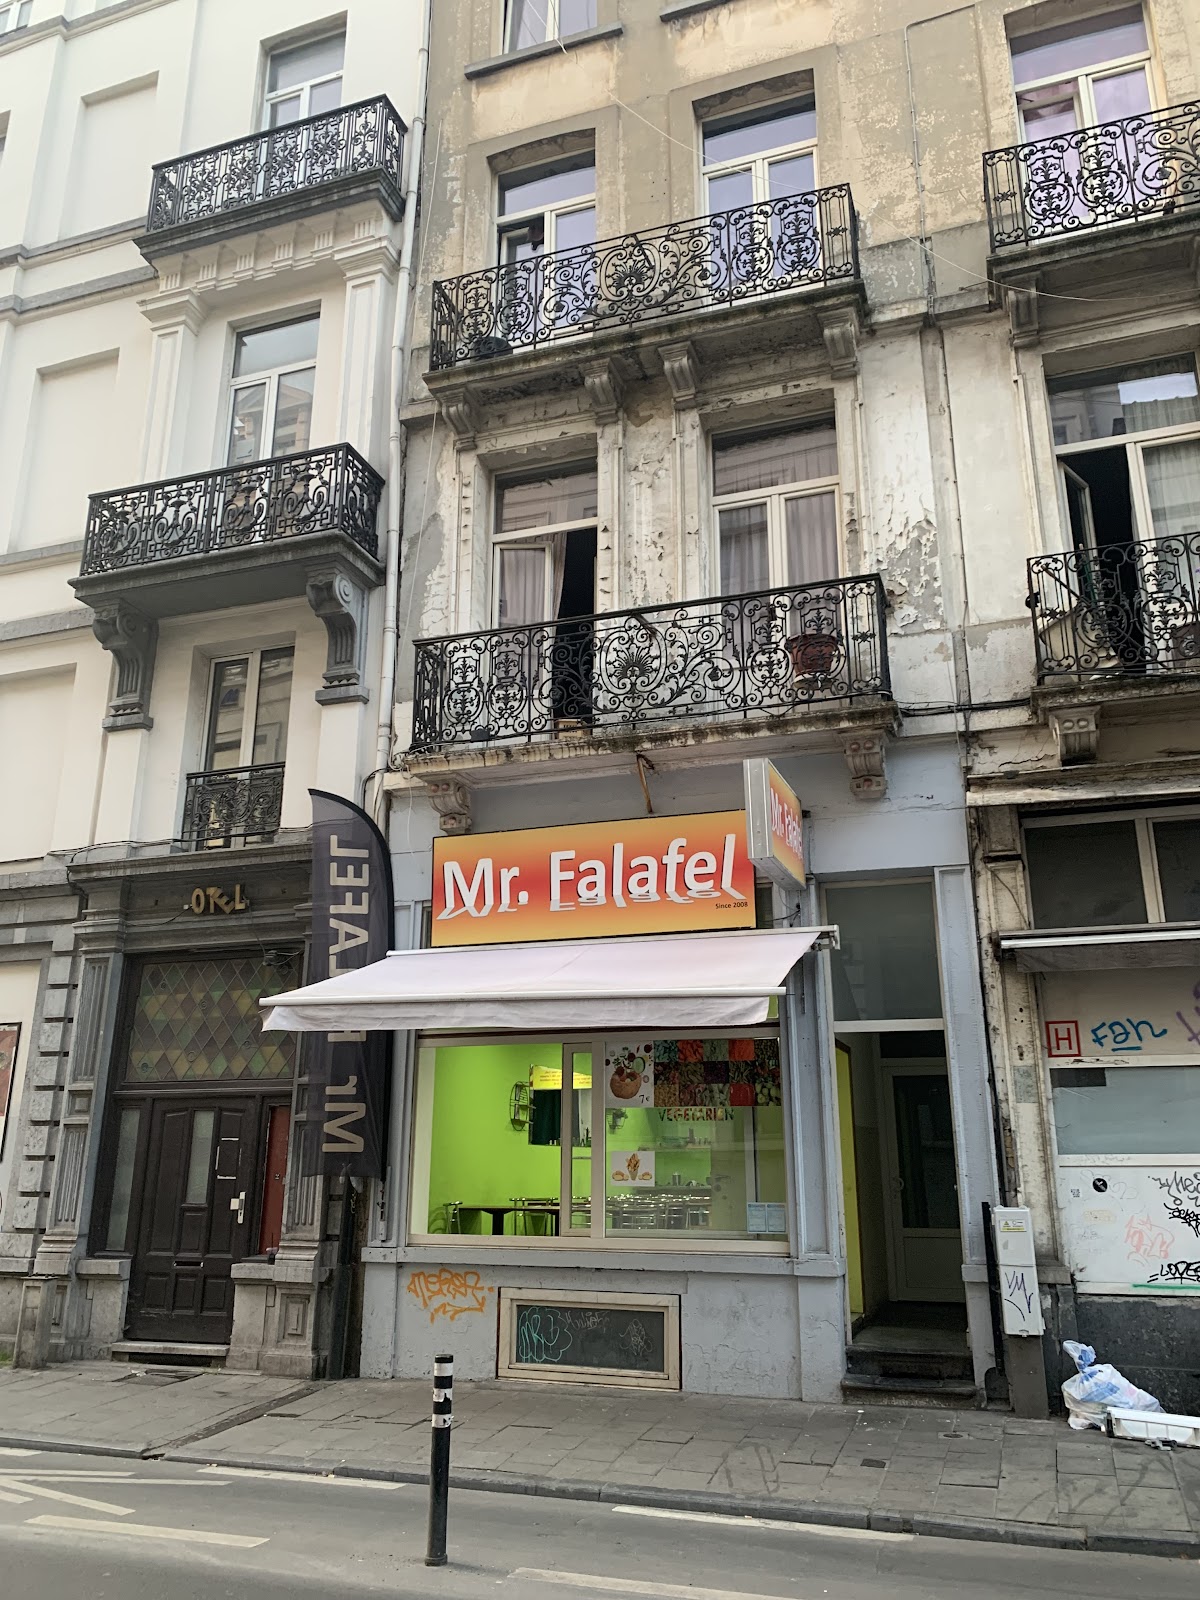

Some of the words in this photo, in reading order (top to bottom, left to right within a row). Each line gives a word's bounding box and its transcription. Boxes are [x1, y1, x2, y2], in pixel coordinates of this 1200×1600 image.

[440, 857, 529, 914] Mr.
[549, 833, 743, 908] Falafel
[715, 902, 732, 910] Since
[1054, 1027, 1073, 1051] H
